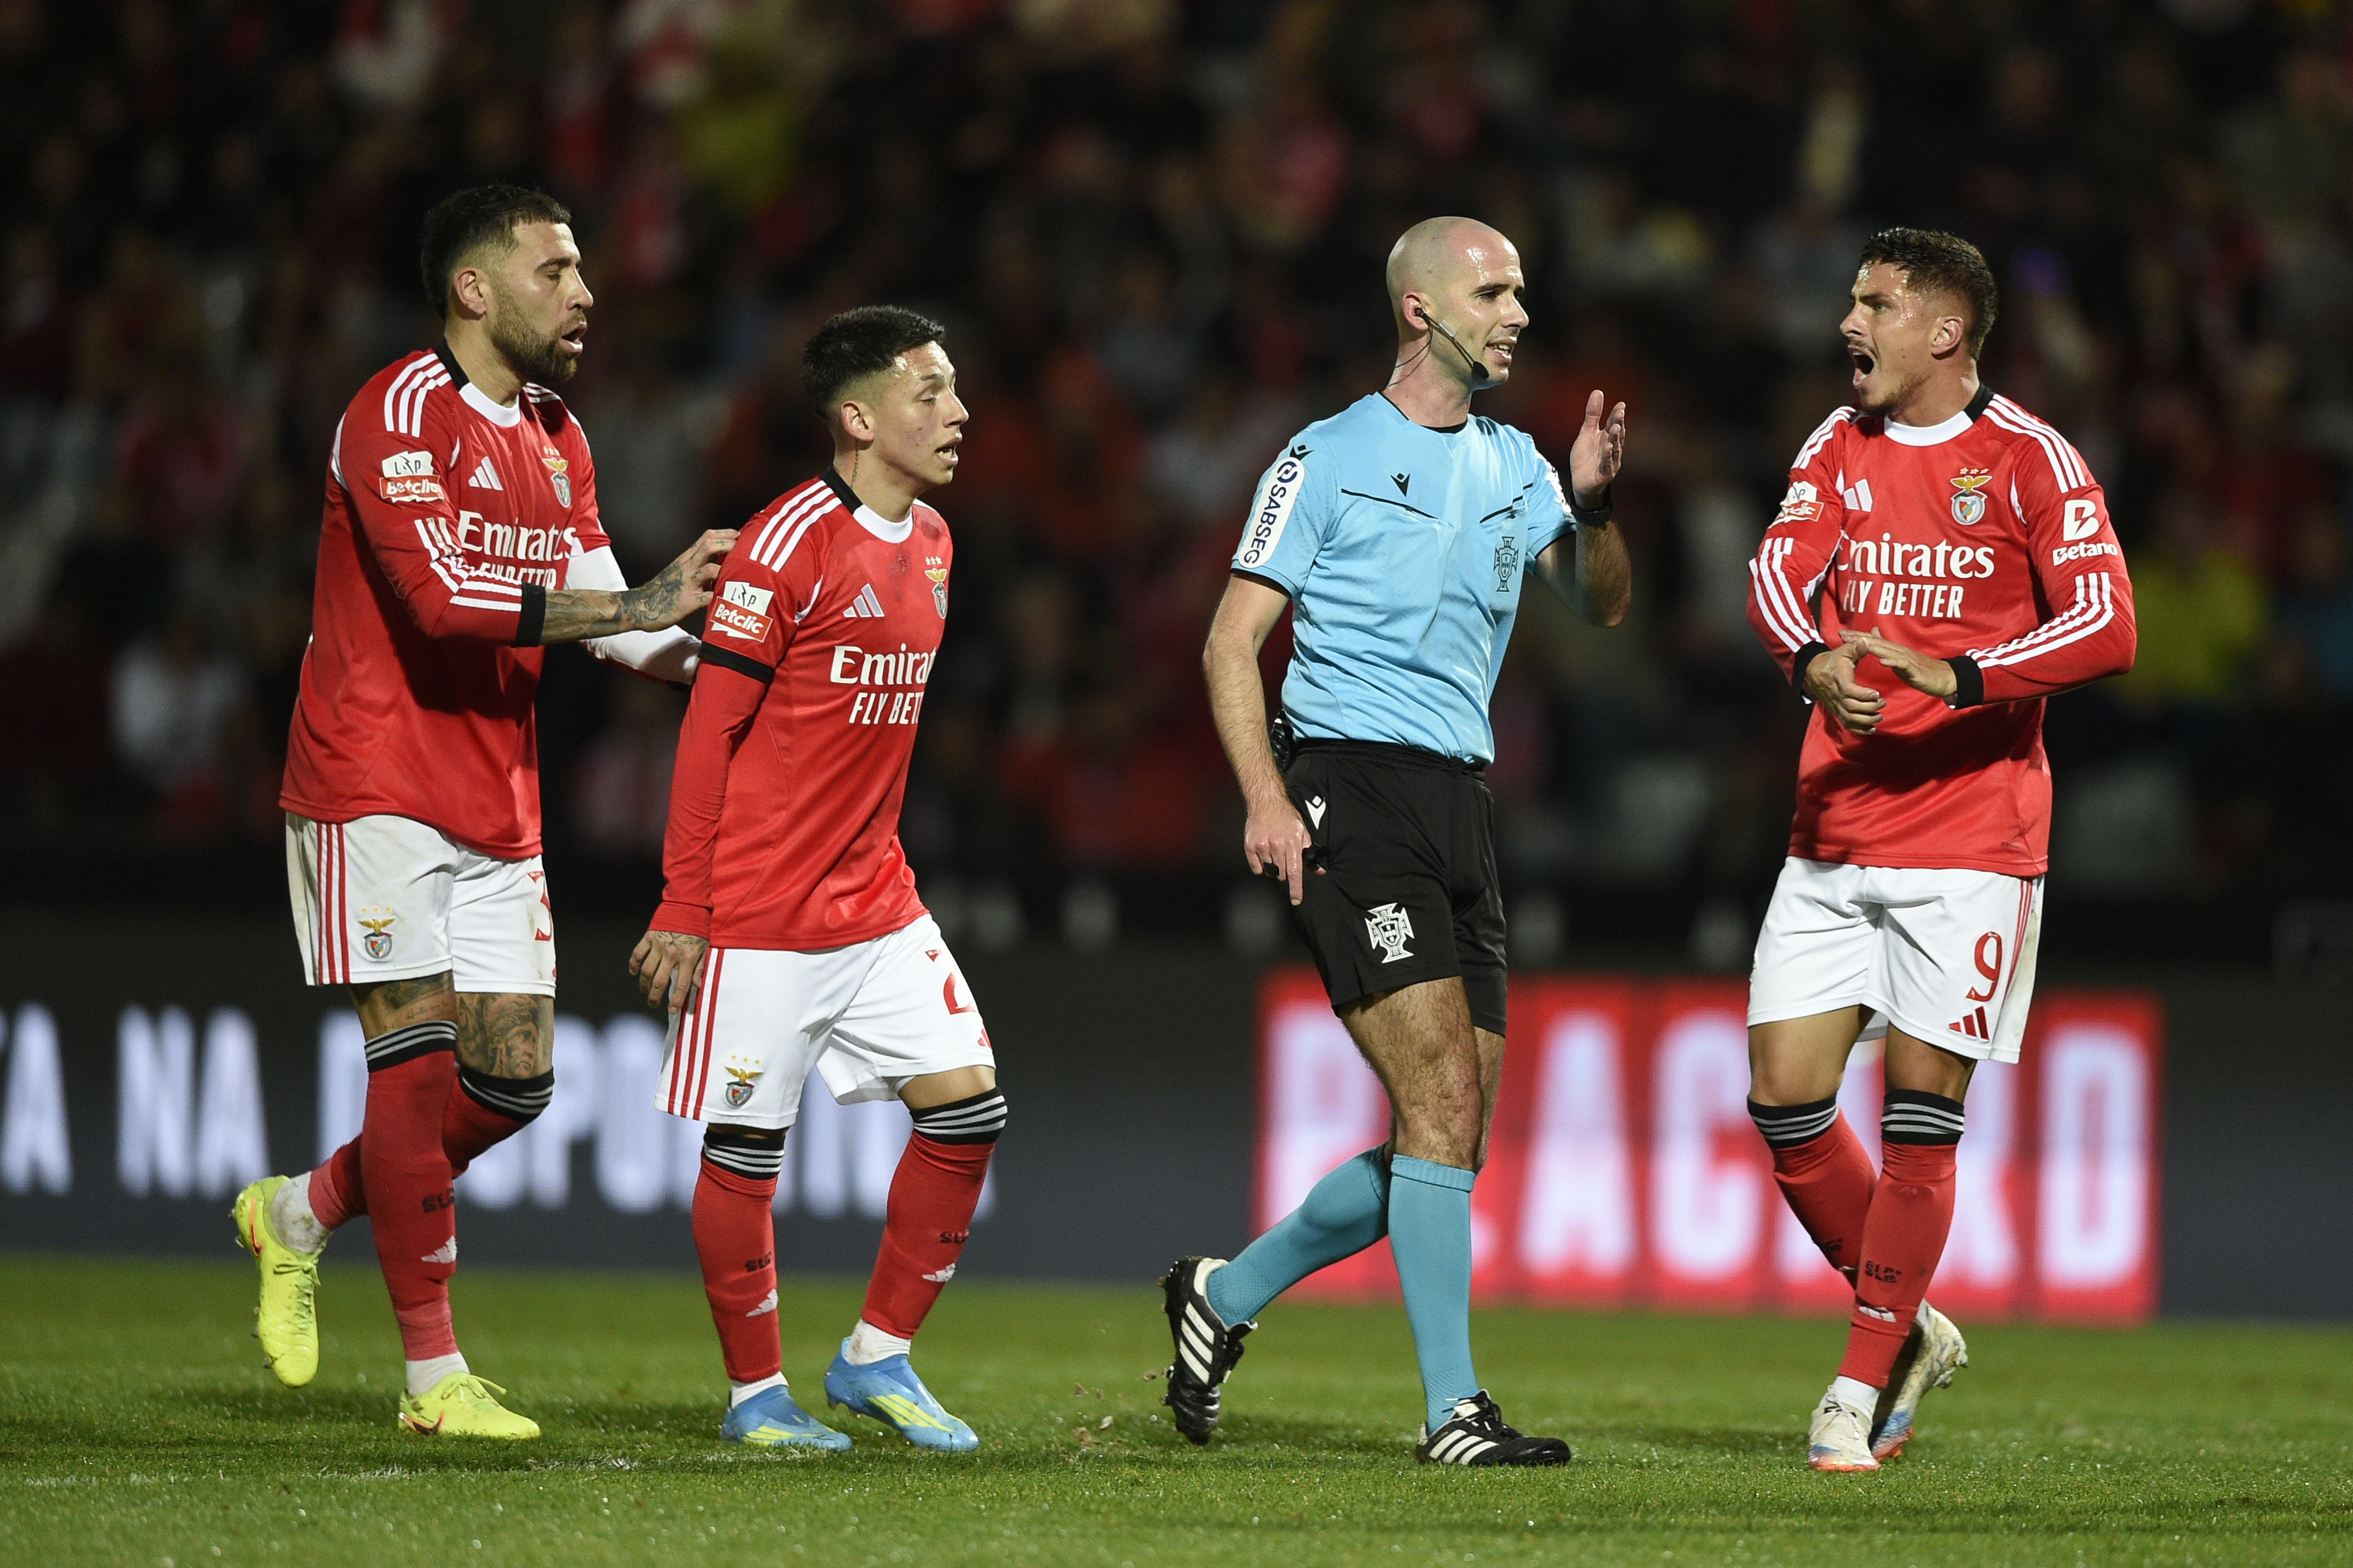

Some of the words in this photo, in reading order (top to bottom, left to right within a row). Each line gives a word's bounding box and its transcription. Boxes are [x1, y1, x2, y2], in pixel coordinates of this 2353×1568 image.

[1244, 483, 1286, 564] SABSEG
[2052, 541, 2118, 567] Betano
[714, 603, 764, 634] Betclic
[1877, 582, 1964, 618] BETTER
[848, 692, 889, 724] FLY
[1965, 931, 2003, 1003] 9
[115, 1001, 271, 1200] NA
[1265, 1002, 2153, 1293] PACRD
